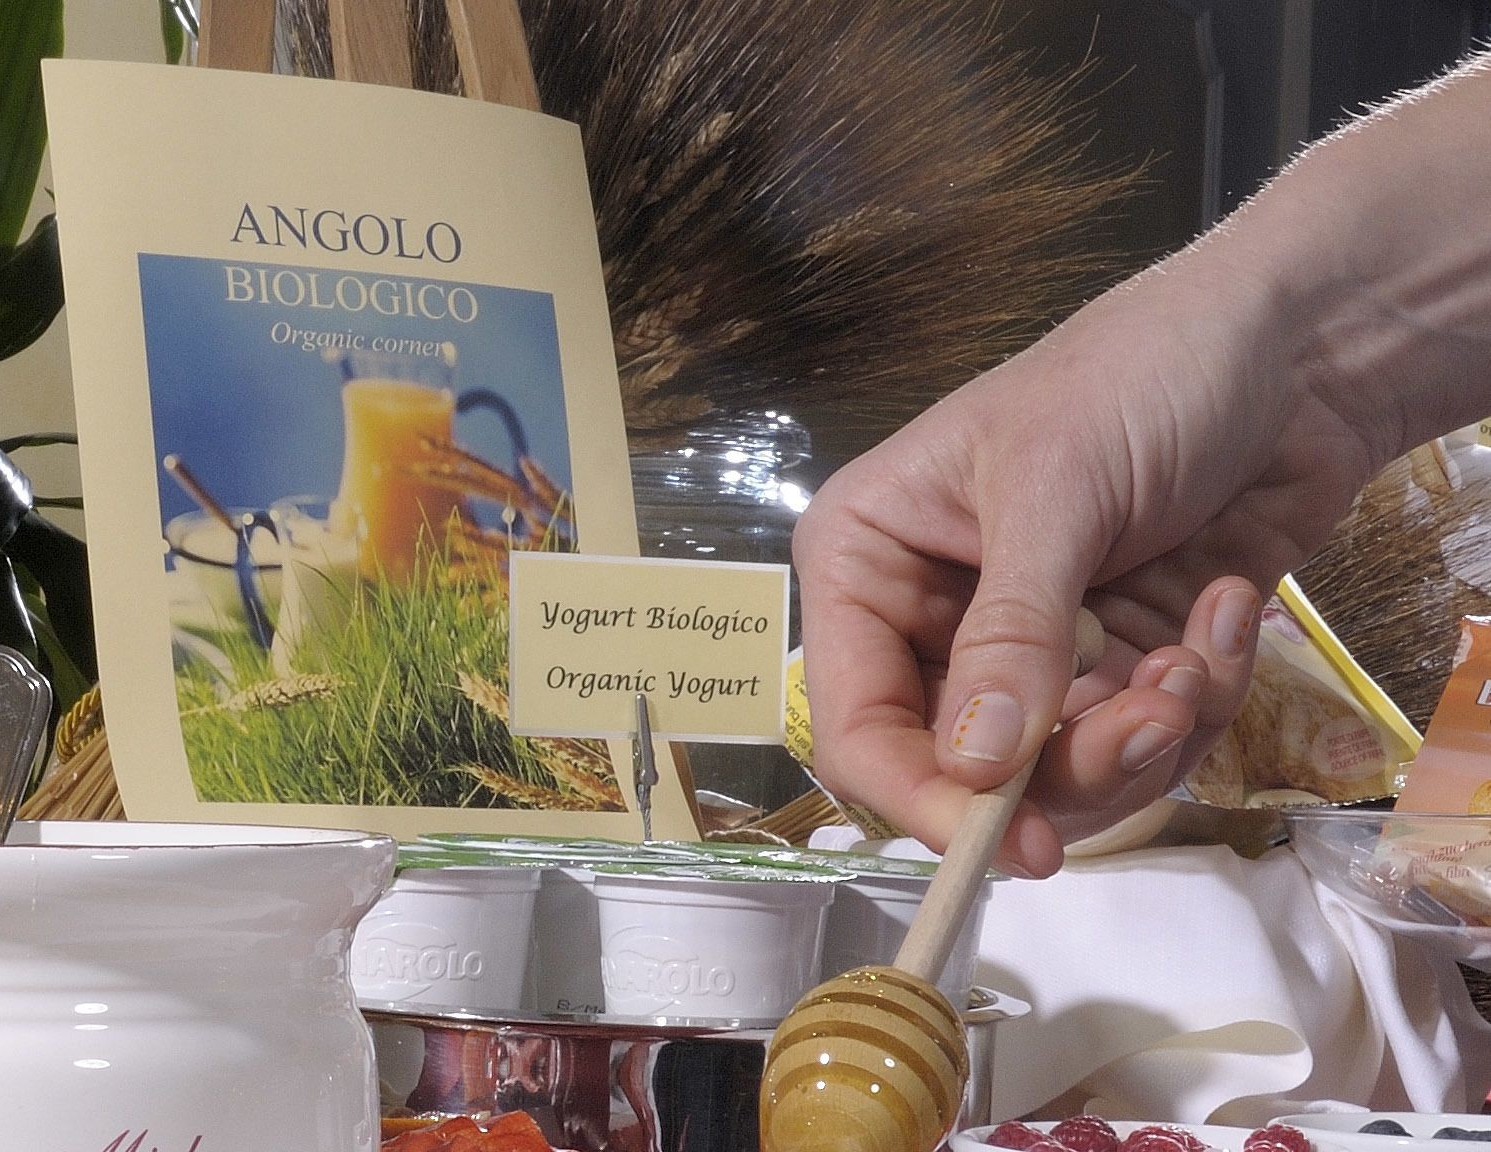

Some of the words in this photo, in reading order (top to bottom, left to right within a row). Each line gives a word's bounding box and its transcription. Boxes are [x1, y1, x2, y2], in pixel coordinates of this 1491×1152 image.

[230, 203, 462, 263] ANGOLO
[225, 266, 478, 323] BIOLOGICO
[271, 322, 364, 351] Organic
[372, 334, 443, 357] corner
[541, 602, 636, 634] Yogurt
[647, 606, 768, 640] Biologico
[547, 666, 656, 698] Organic
[668, 671, 760, 703] Yogurt
[359, 946, 483, 982] AROLO
[602, 957, 736, 997] AROLO
